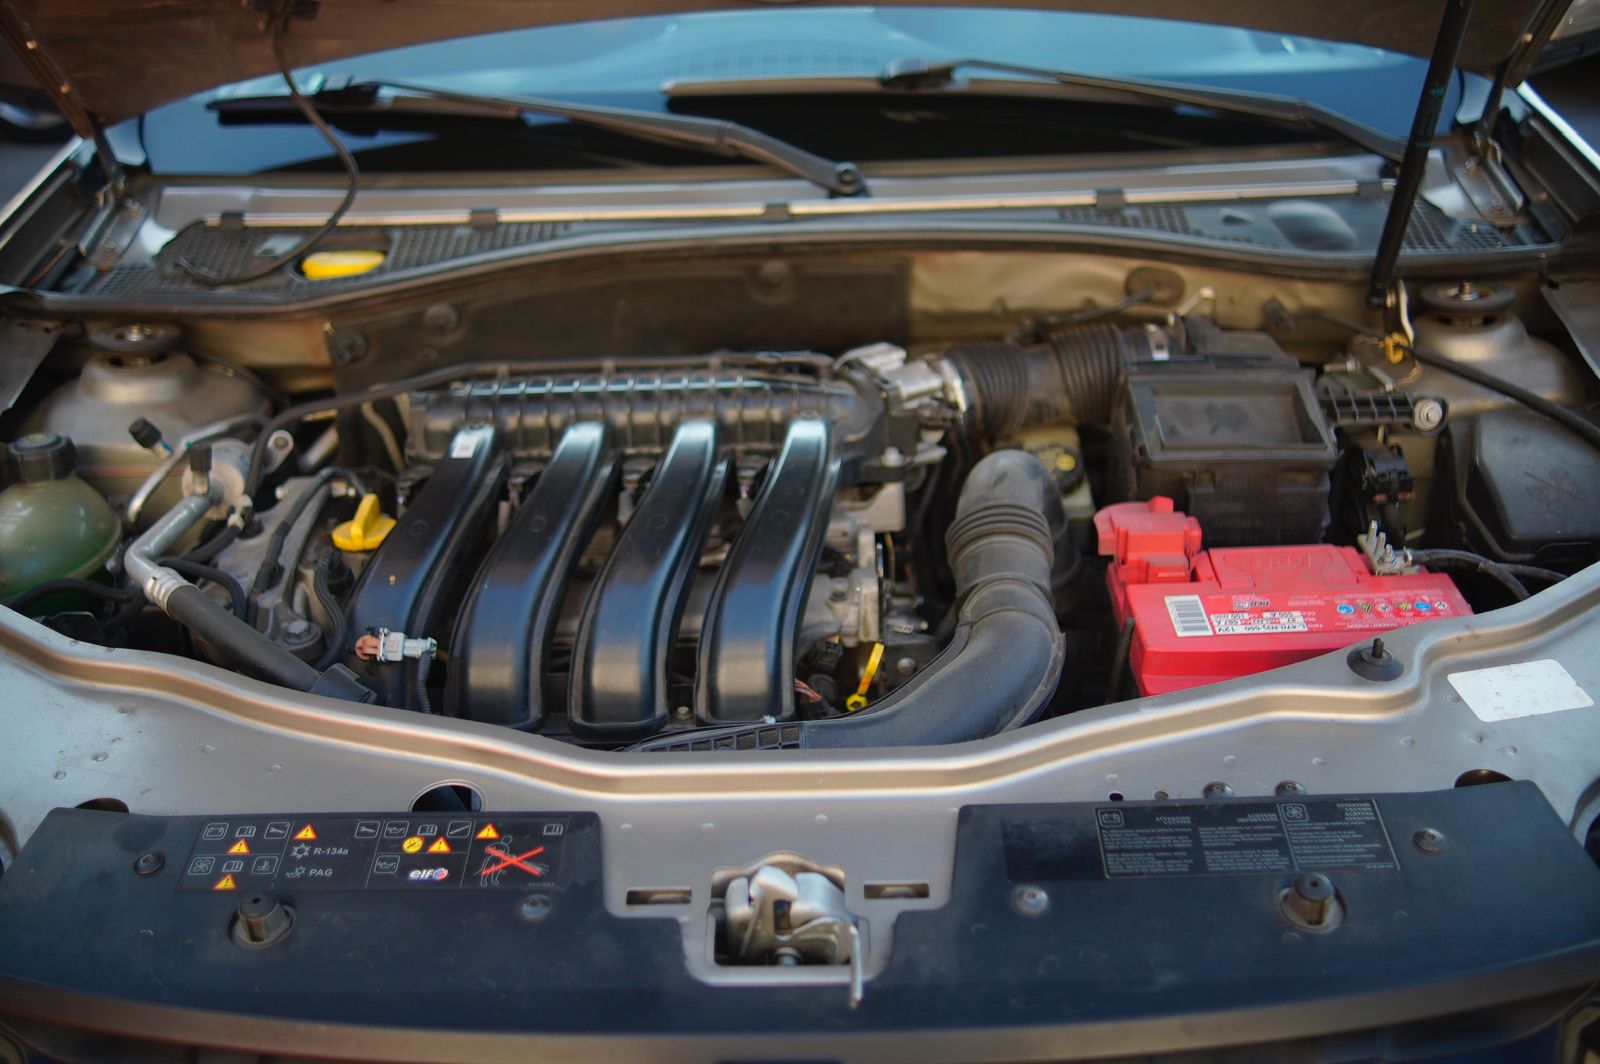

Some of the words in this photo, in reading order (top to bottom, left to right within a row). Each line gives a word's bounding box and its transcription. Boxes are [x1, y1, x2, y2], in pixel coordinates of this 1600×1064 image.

[313, 847, 349, 855] R-134a
[309, 868, 333, 876] PAG
[409, 868, 437, 879] elf
